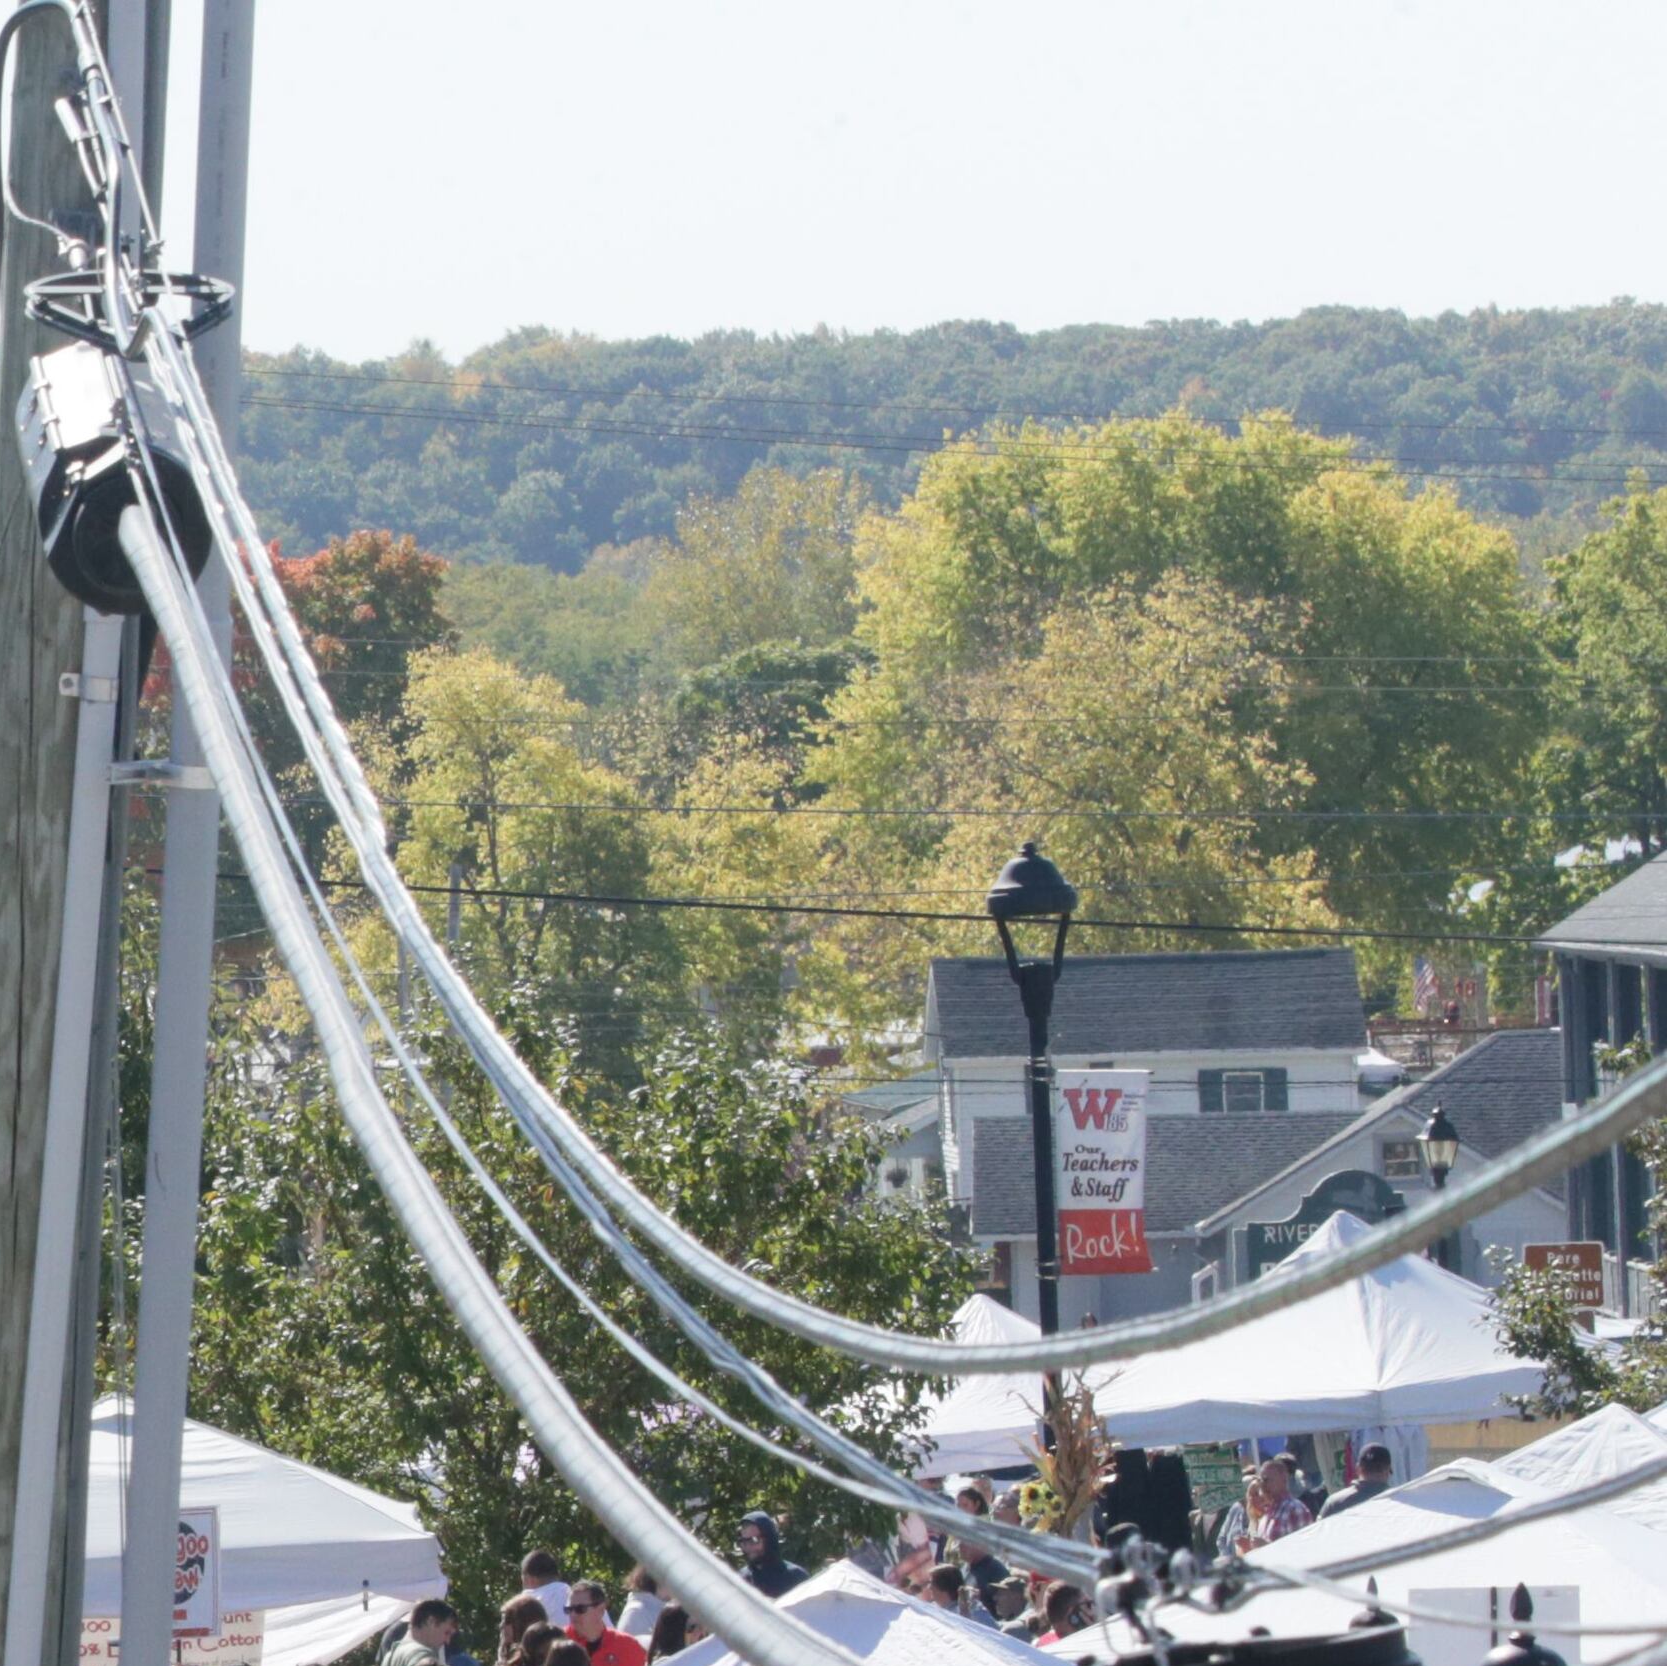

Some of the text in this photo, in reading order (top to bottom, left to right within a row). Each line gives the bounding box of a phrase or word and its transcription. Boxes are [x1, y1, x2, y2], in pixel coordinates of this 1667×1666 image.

[1075, 1144, 1101, 1155] Our
[1062, 1153, 1139, 1172] Teachers
[1066, 1211, 1140, 1264] Rock!
[1546, 1251, 1580, 1266] Pere
